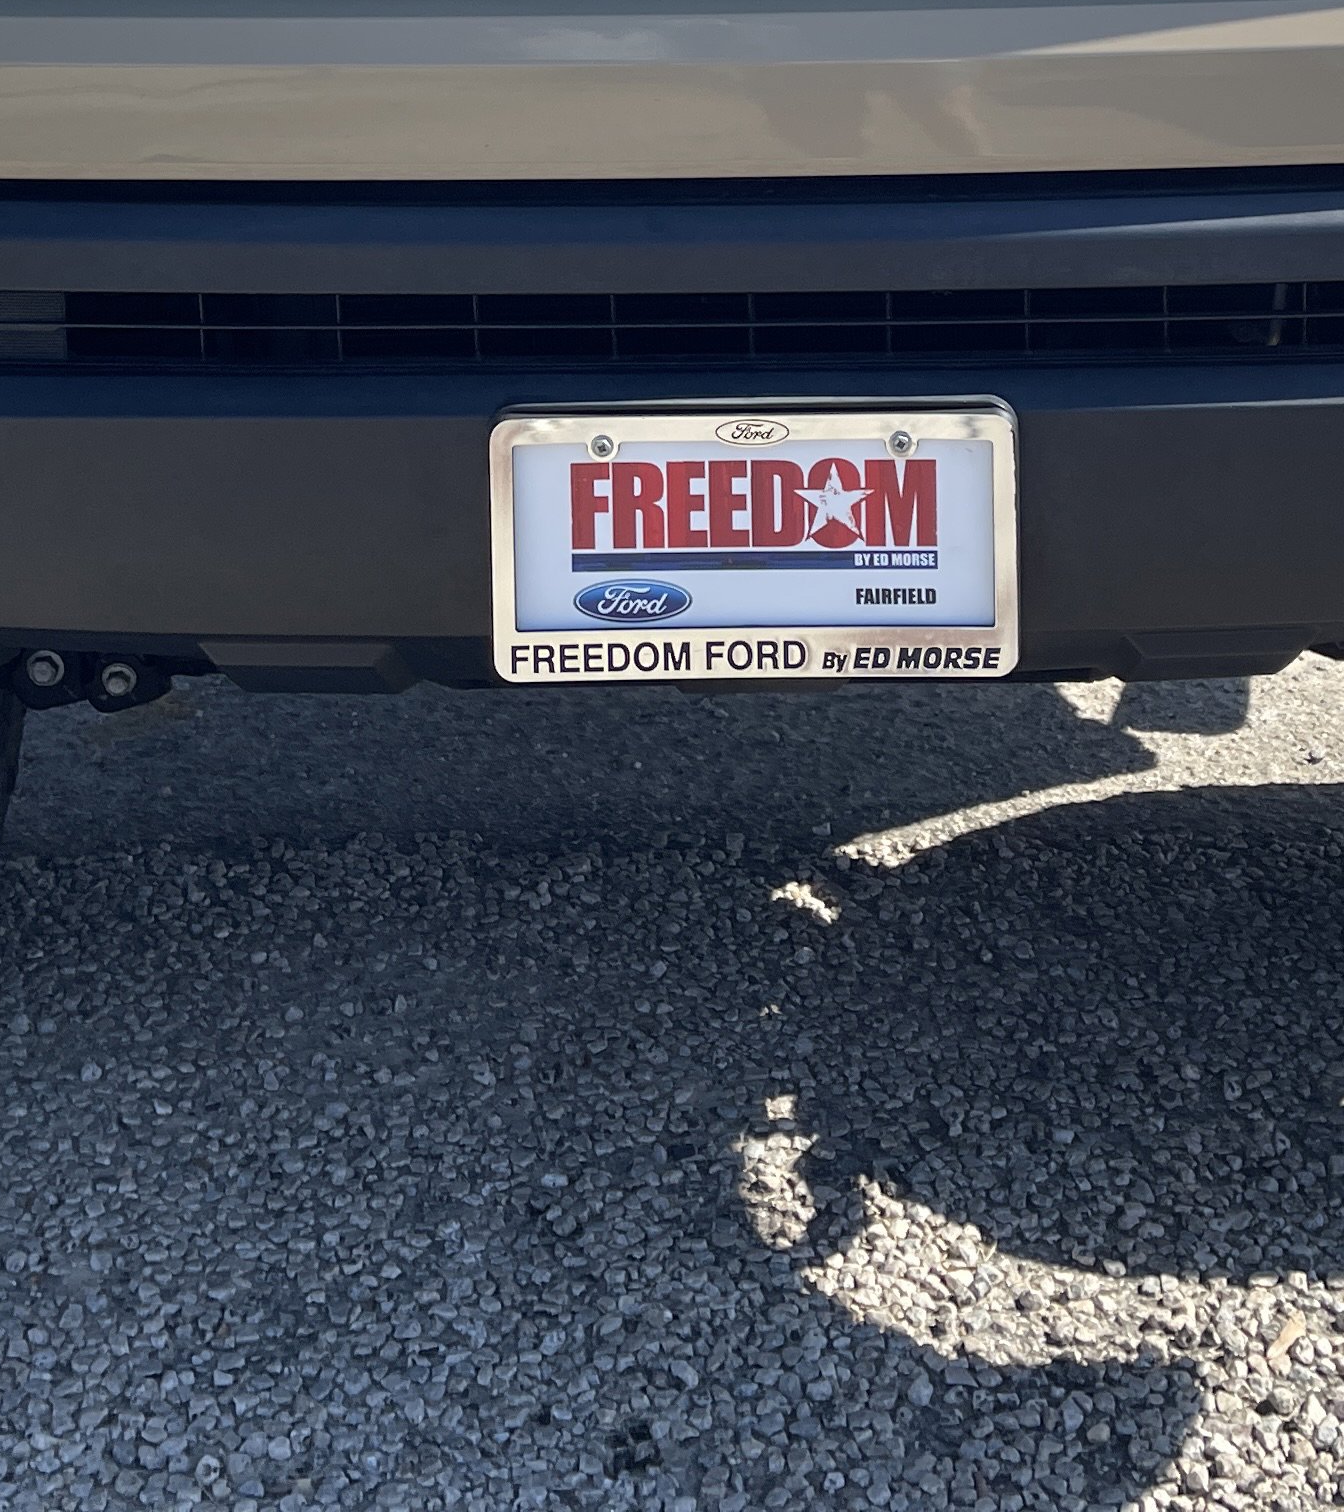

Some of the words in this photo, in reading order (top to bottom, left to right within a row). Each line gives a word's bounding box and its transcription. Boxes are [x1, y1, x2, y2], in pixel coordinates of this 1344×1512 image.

[731, 422, 775, 440] Ford
[570, 457, 938, 550] FREEDOM
[854, 553, 871, 566] BY
[873, 553, 889, 566] ED
[891, 552, 936, 566] MORSE
[597, 585, 669, 615] Ford
[855, 588, 937, 605] FAIRFIELD
[511, 641, 691, 674] FREEDOM
[706, 640, 807, 671] FORD
[822, 651, 847, 672] By
[853, 647, 891, 669] ED
[896, 647, 1001, 669] MORSE
